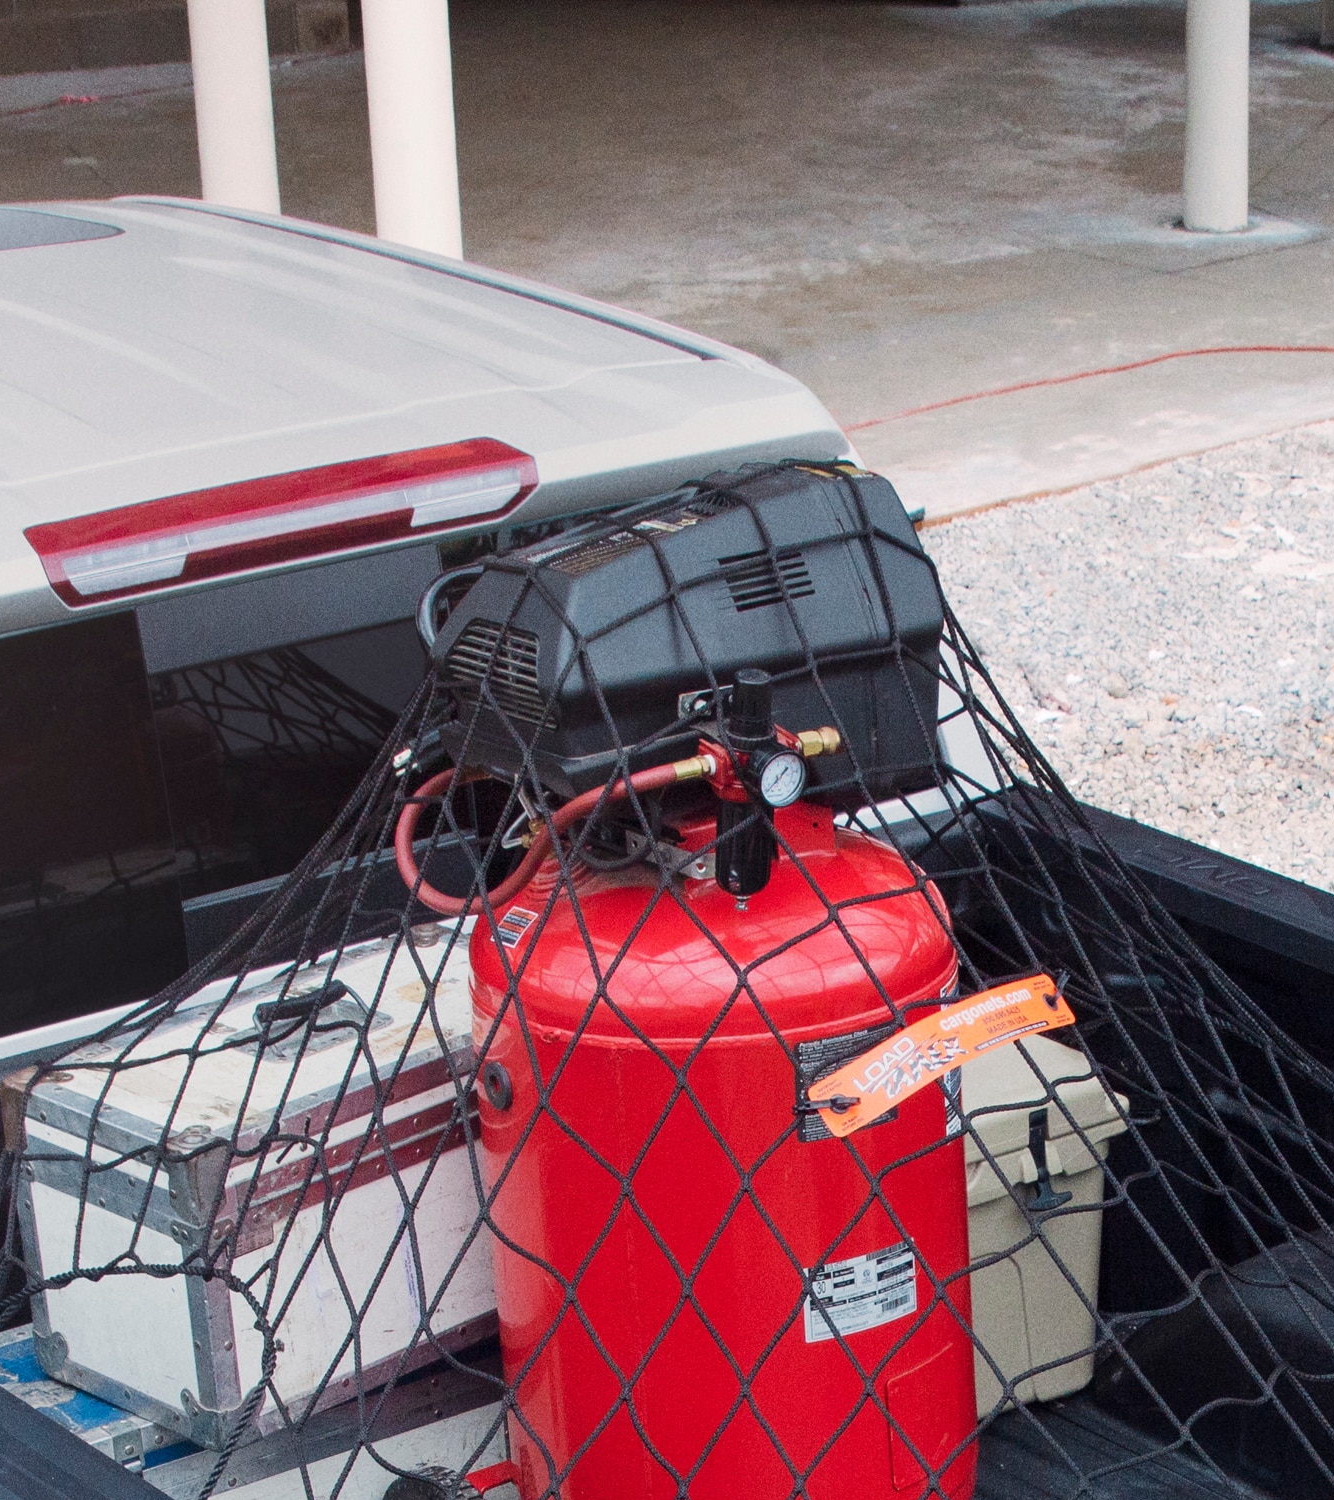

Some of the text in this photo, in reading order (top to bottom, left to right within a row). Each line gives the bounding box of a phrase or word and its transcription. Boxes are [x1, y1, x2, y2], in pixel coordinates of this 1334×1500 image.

[939, 987, 1032, 1032] cargonets.com
[987, 1022, 1007, 1034] MADE
[1016, 1014, 1029, 1025] USA
[852, 1036, 916, 1093] LOAD
[816, 1281, 827, 1295] 30
